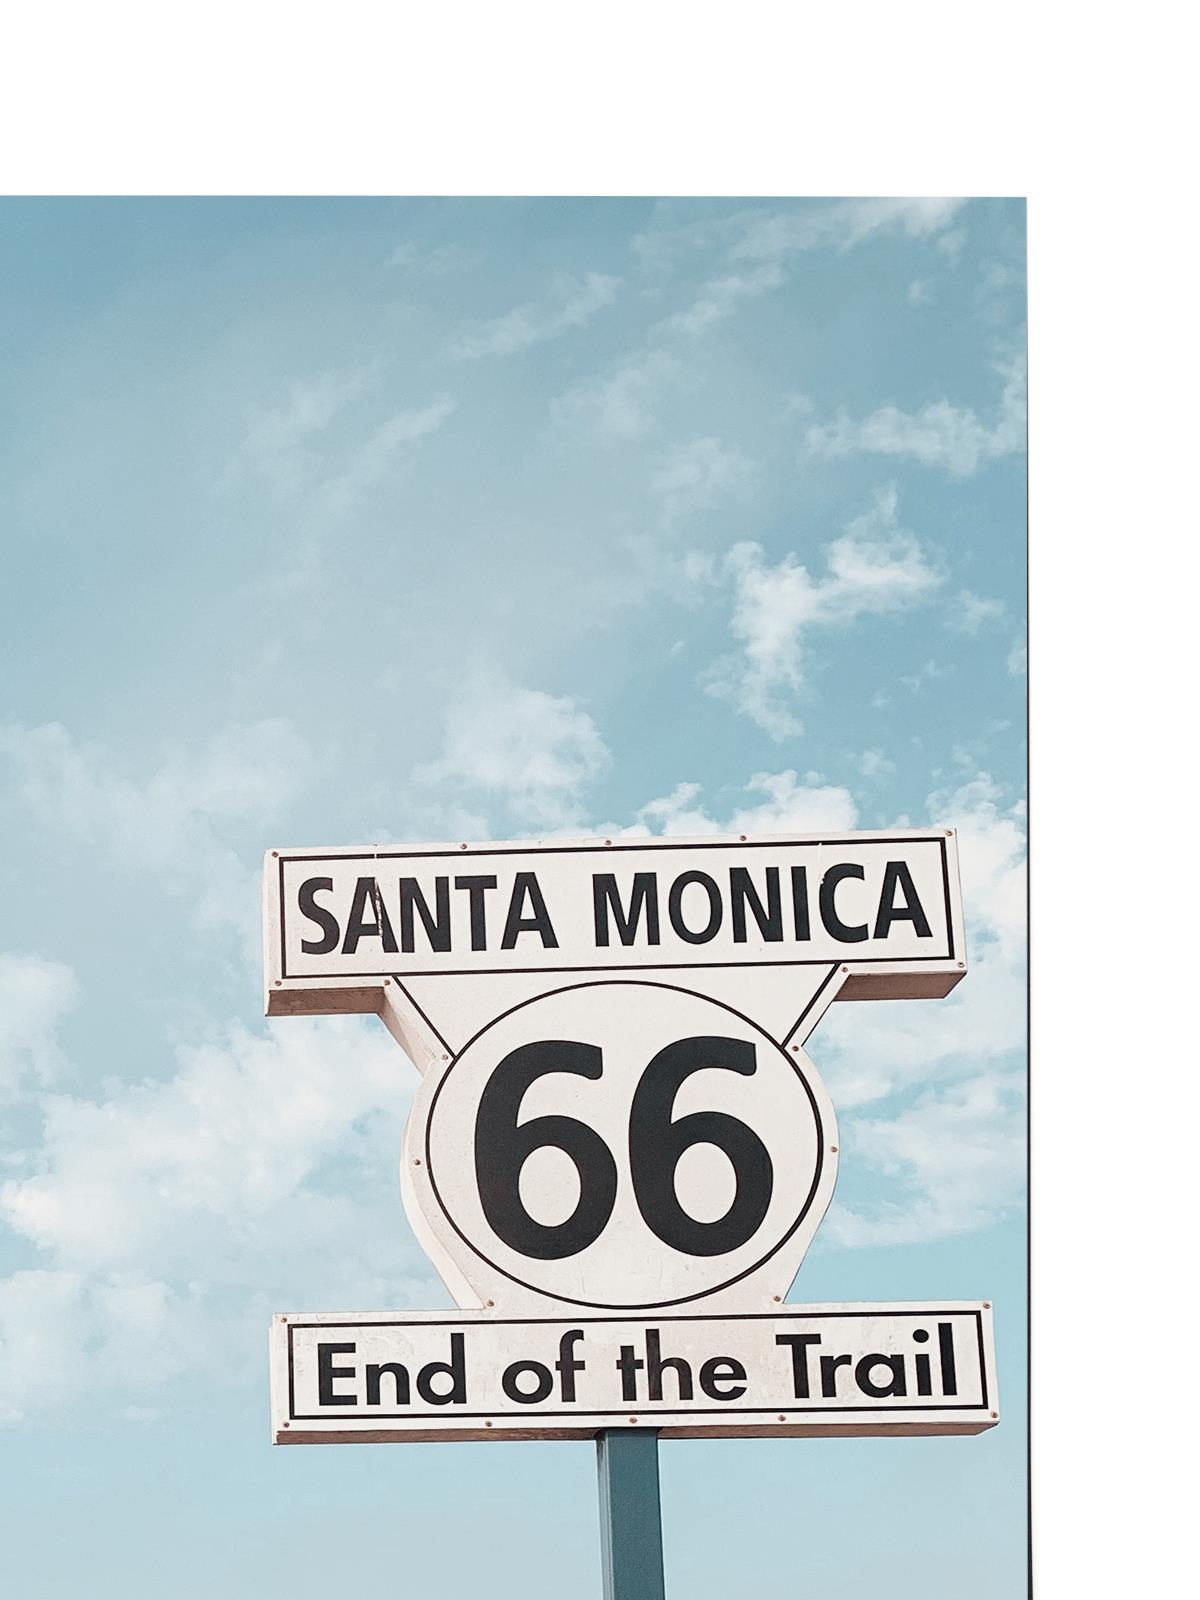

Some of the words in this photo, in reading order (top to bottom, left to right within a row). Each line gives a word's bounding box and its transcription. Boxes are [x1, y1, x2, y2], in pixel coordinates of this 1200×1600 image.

[299, 872, 560, 955] SANTA
[592, 860, 933, 949] MONICA
[474, 1035, 774, 1261] 66
[317, 1332, 467, 1407] End
[500, 1329, 585, 1405] of
[615, 1328, 748, 1402] the
[775, 1322, 959, 1400] Trail
